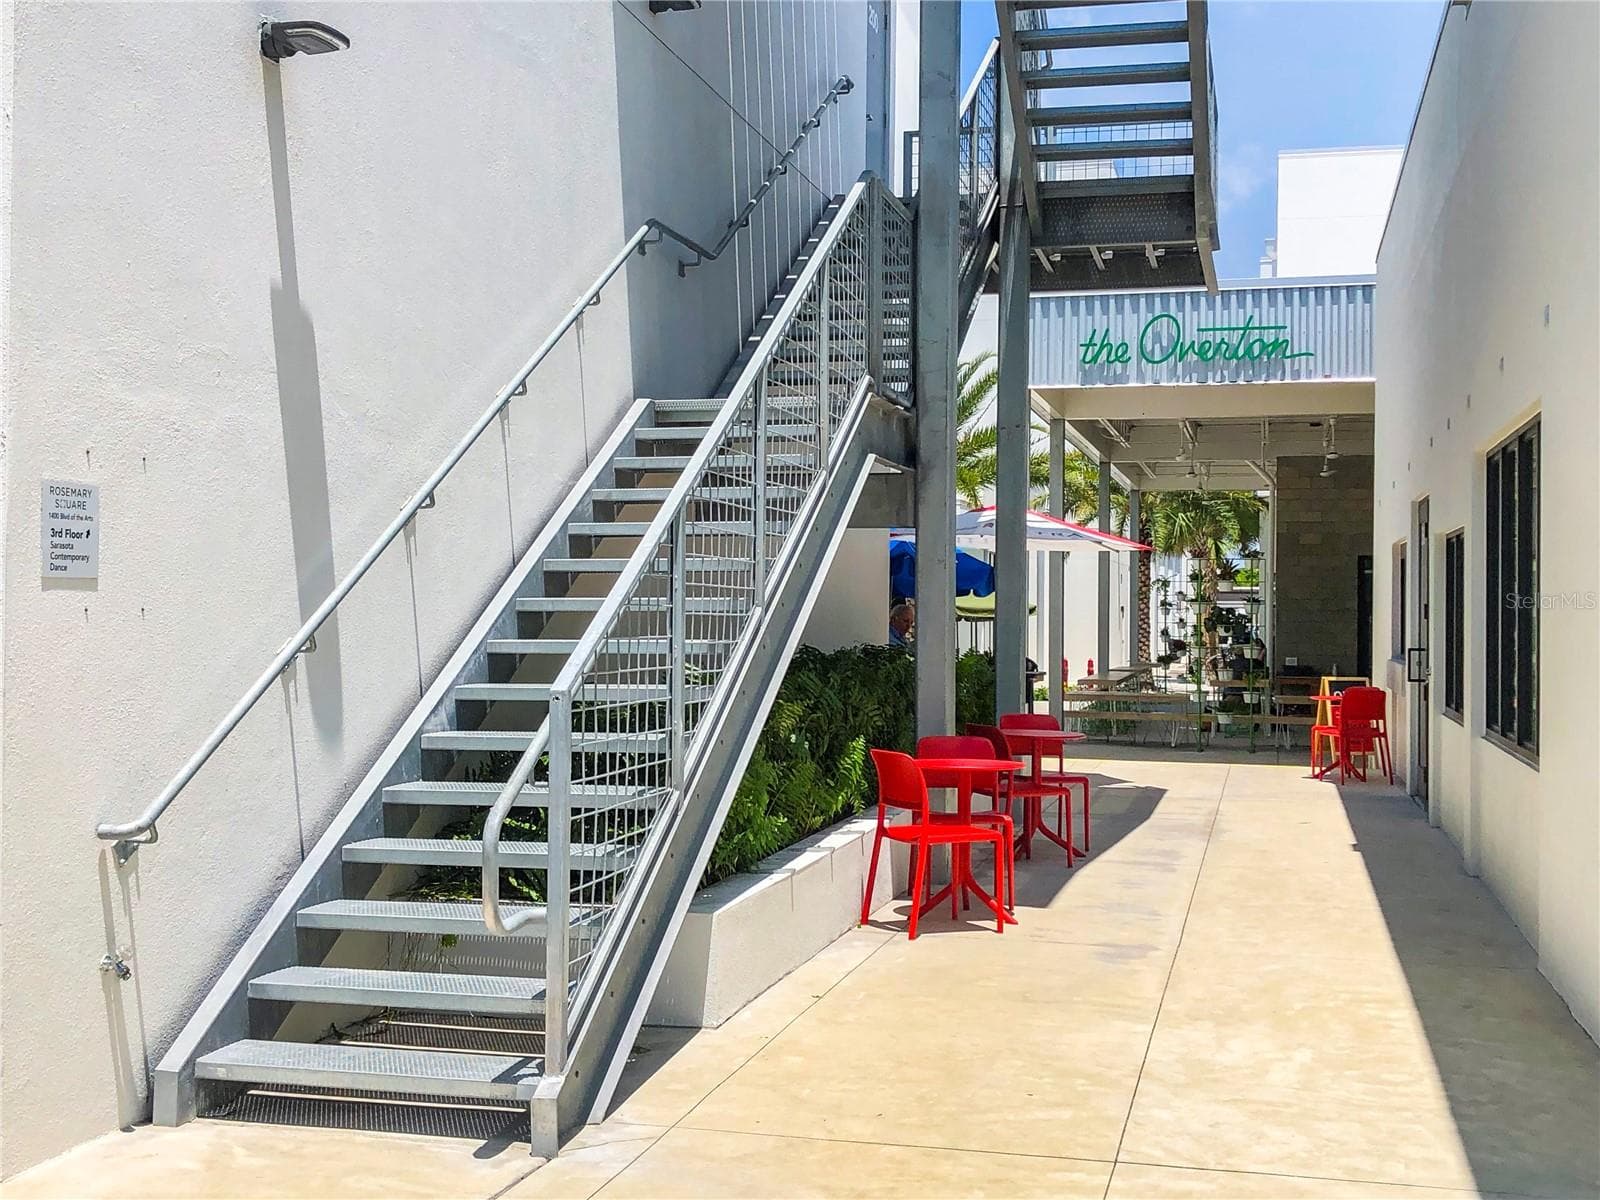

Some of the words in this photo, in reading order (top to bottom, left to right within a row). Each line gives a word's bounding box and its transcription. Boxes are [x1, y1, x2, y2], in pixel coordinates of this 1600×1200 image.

[1080, 328, 1131, 364] the
[1140, 313, 1314, 365] Overton
[49, 485, 93, 499] ROSEMARY
[60, 512, 70, 520] Blvd
[71, 513, 76, 521] of
[76, 513, 84, 521] the
[84, 514, 94, 522] Arts
[50, 527, 63, 538] 3rd
[65, 528, 84, 539] Floor
[50, 541, 74, 550] Sarasota
[50, 551, 90, 563] Contemporary
[50, 562, 67, 572] Dance
